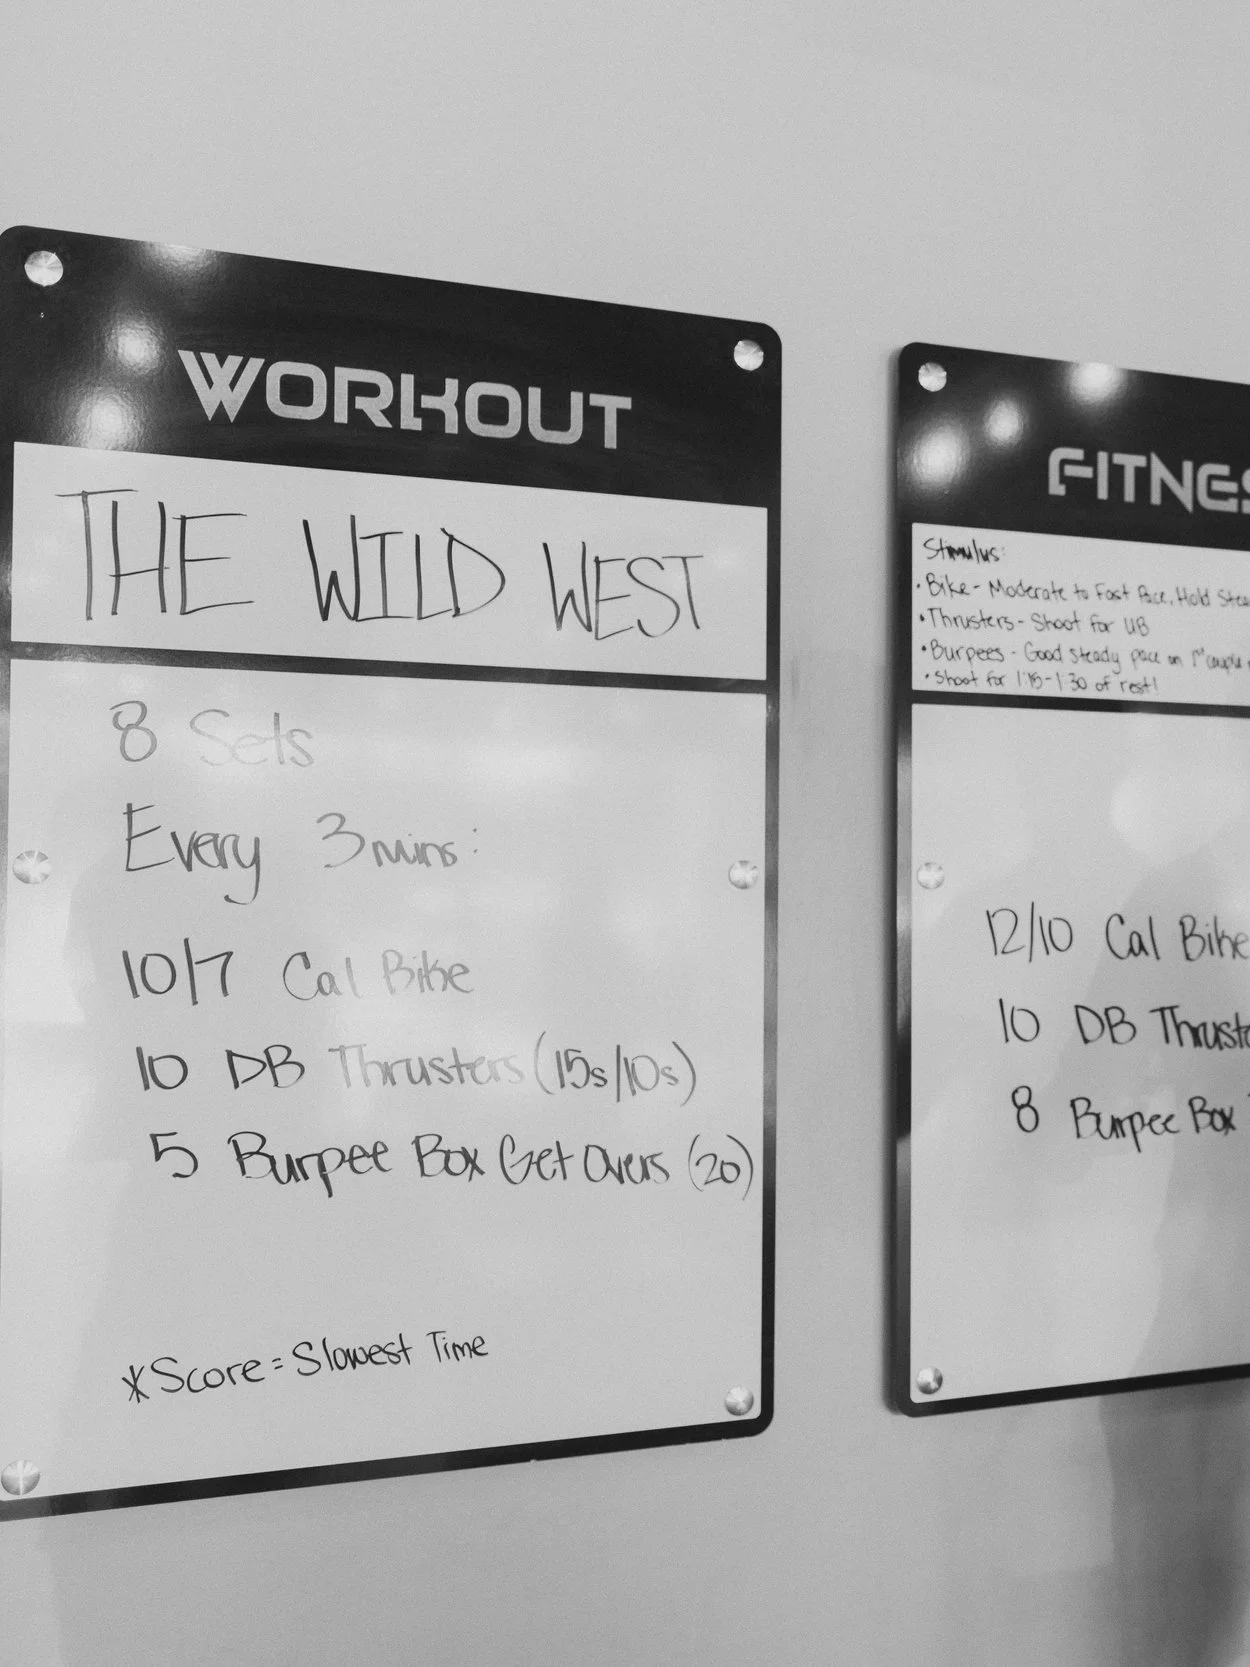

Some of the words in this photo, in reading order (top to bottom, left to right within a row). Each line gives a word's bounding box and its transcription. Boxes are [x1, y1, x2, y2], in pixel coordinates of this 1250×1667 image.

[177, 349, 633, 450] WORKOUT
[55, 489, 256, 621] THE
[302, 514, 506, 623] WILD
[542, 541, 704, 641] WEST
[989, 578, 1068, 601] Moderate
[1074, 584, 1089, 600] to
[1024, 641, 1063, 663] Good
[110, 700, 159, 763] 8
[189, 709, 315, 770] Sets
[123, 802, 264, 906] Every
[315, 811, 367, 870] 3
[985, 901, 1075, 963] 12/10
[1104, 912, 1161, 962] Cal
[1178, 914, 1250, 962] Bike
[121, 938, 236, 1007] 10/7
[282, 951, 360, 1000] Cal
[380, 949, 475, 996] Bike
[998, 997, 1041, 1044] 10
[1074, 1003, 1137, 1045] DB
[135, 1045, 190, 1092] 10
[227, 1043, 305, 1090] DB
[330, 1042, 527, 1088] Thrusters
[1011, 1085, 1040, 1134] 8
[1069, 1095, 1181, 1153] Burpee
[1187, 1095, 1237, 1136] Box
[150, 1131, 199, 1179] 5
[228, 1132, 394, 1198] Burpee
[413, 1132, 486, 1179] Box
[687, 1133, 754, 1201] (20)
[429, 1328, 490, 1362] Time
